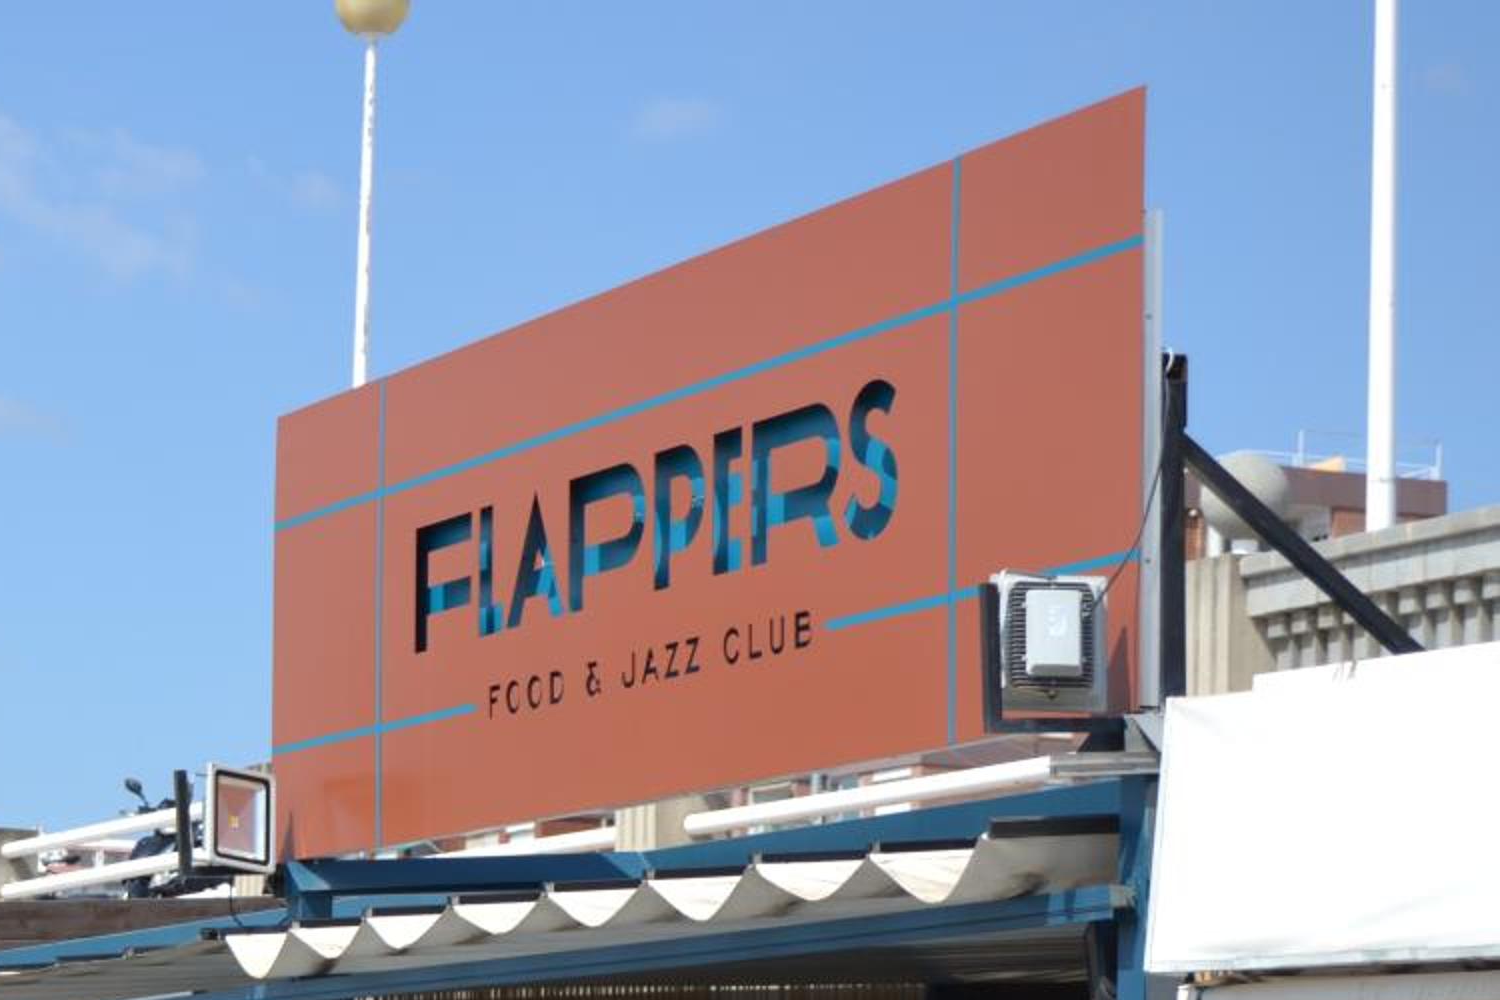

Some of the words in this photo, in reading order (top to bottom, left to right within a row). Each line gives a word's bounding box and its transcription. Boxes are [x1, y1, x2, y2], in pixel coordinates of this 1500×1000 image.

[414, 378, 898, 654] FLAPPERS
[488, 670, 563, 720] FOOD
[585, 661, 602, 697] &
[621, 636, 701, 689] JAZZ
[723, 610, 812, 665] CLUB
